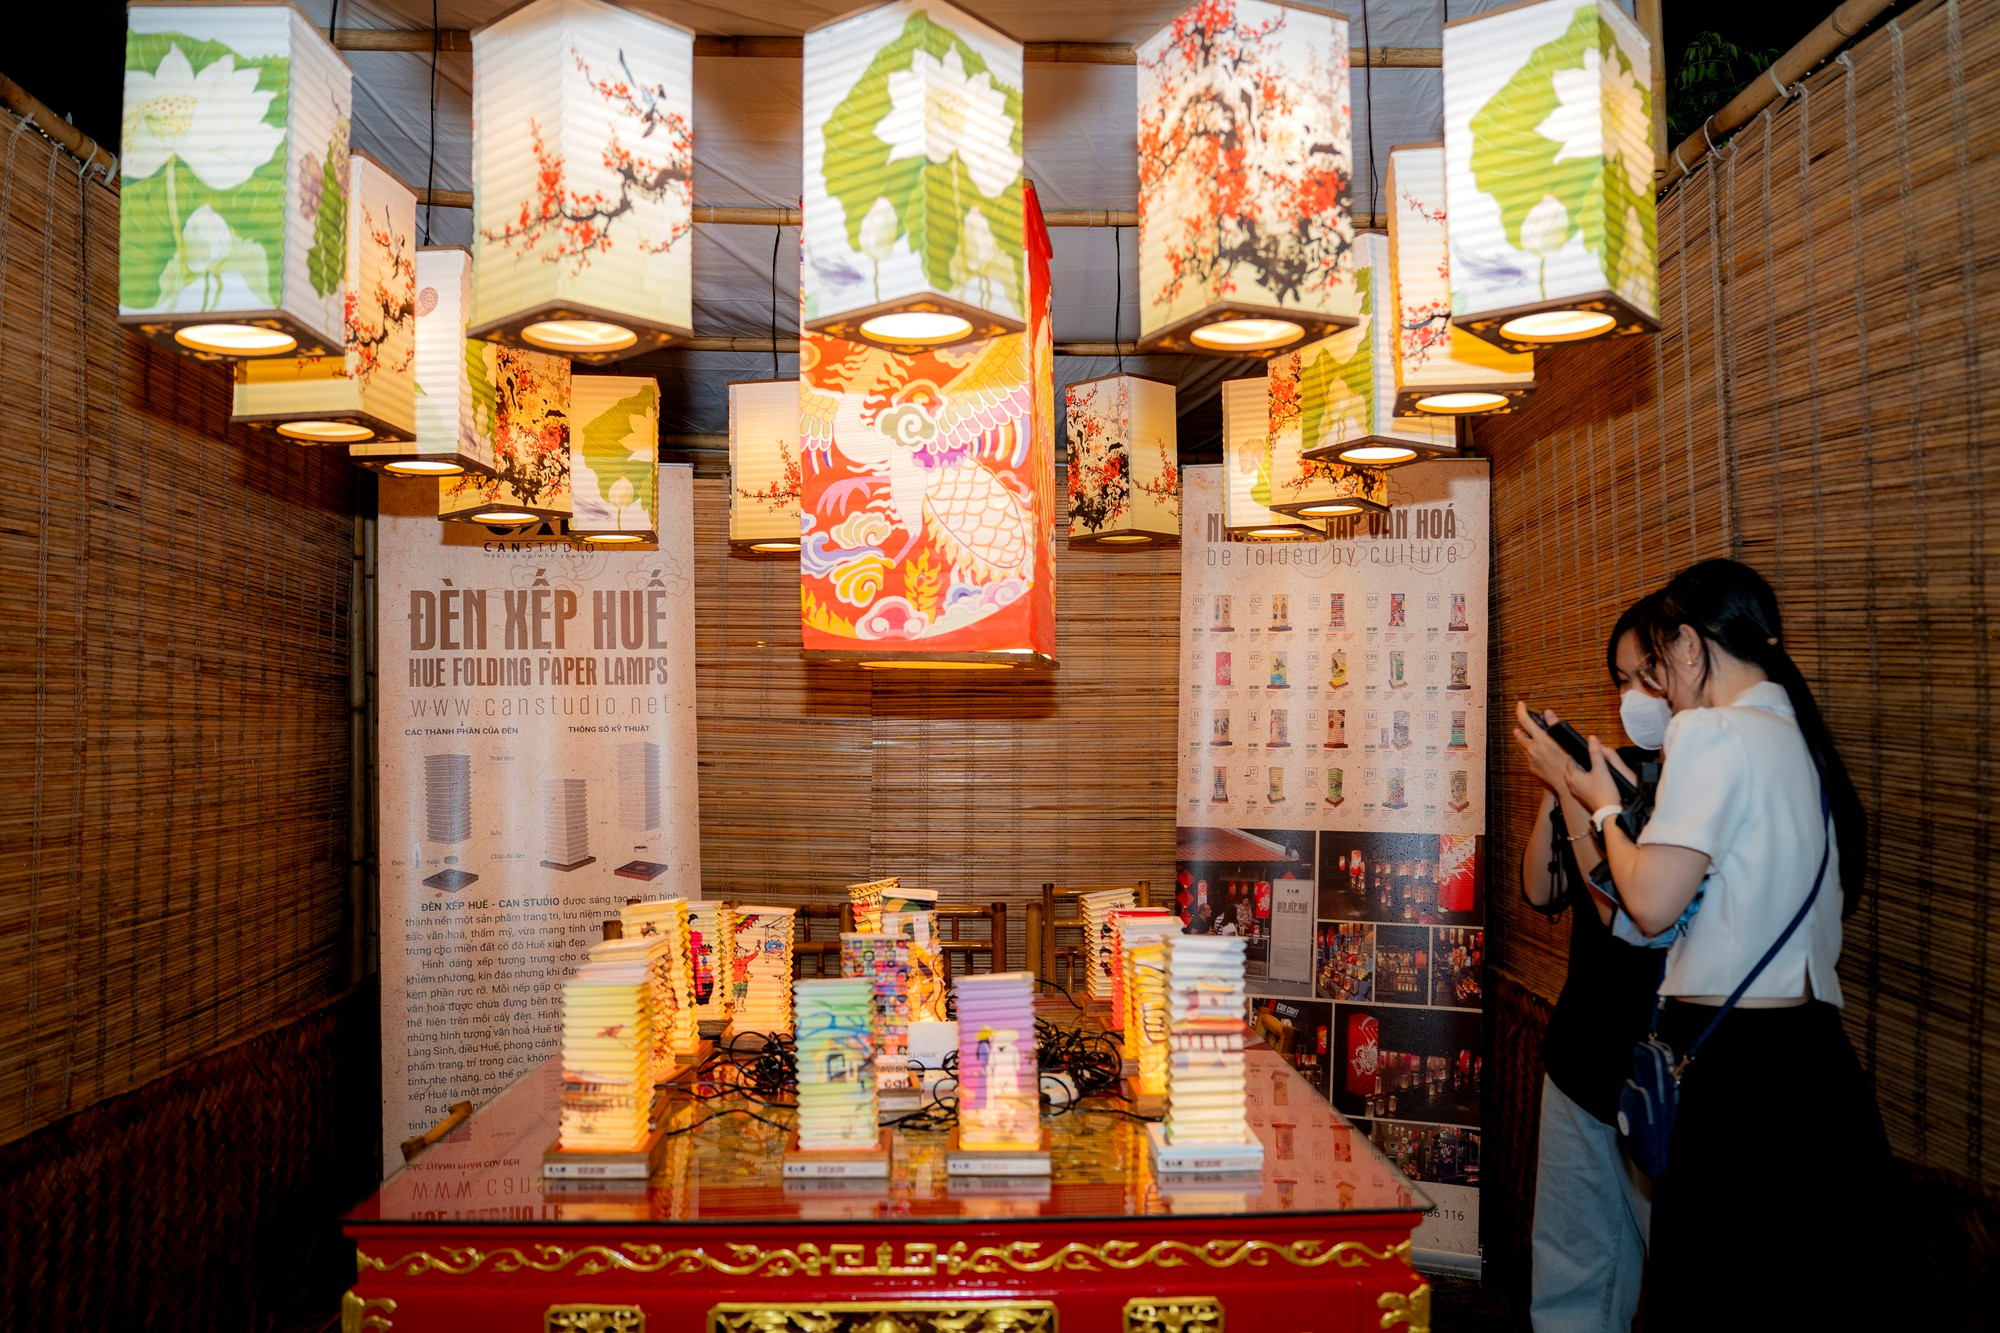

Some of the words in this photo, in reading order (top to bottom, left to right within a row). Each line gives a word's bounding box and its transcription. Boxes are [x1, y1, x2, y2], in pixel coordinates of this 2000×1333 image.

[1416, 503, 1456, 539] HOÁ
[484, 542, 595, 553] CANSTUDIO
[1207, 547, 1231, 566] be
[1246, 546, 1318, 566] folded
[1332, 544, 1356, 566] by
[1370, 544, 1457, 564] culture
[407, 578, 488, 651] ĐÈN
[504, 568, 578, 650] XẾP
[593, 569, 668, 650] HUẾ
[409, 658, 446, 688] HUE
[453, 657, 532, 687] FOLDING
[539, 657, 597, 686] PAPER
[604, 656, 668, 685] LAMPS
[405, 728, 423, 736] CÁC
[425, 727, 454, 735] THÀNH
[482, 726, 500, 735] CỦA
[568, 725, 596, 733] THÔNG
[421, 901, 442, 912] ĐÈN
[468, 898, 489, 910] HUẾ
[499, 899, 520, 908] CAN
[523, 897, 560, 908] STUDIO
[405, 917, 433, 927] thành
[454, 915, 474, 925] một
[523, 911, 547, 922] trang
[539, 926, 565, 936] mang
[560, 953, 577, 961] cho
[546, 968, 560, 976] khi
[503, 1040, 533, 1051] phong
[438, 1060, 463, 1070] trang
[479, 1057, 504, 1067] trong
[424, 1105, 437, 1114] Ra
[1444, 1209, 1465, 1221] 116
